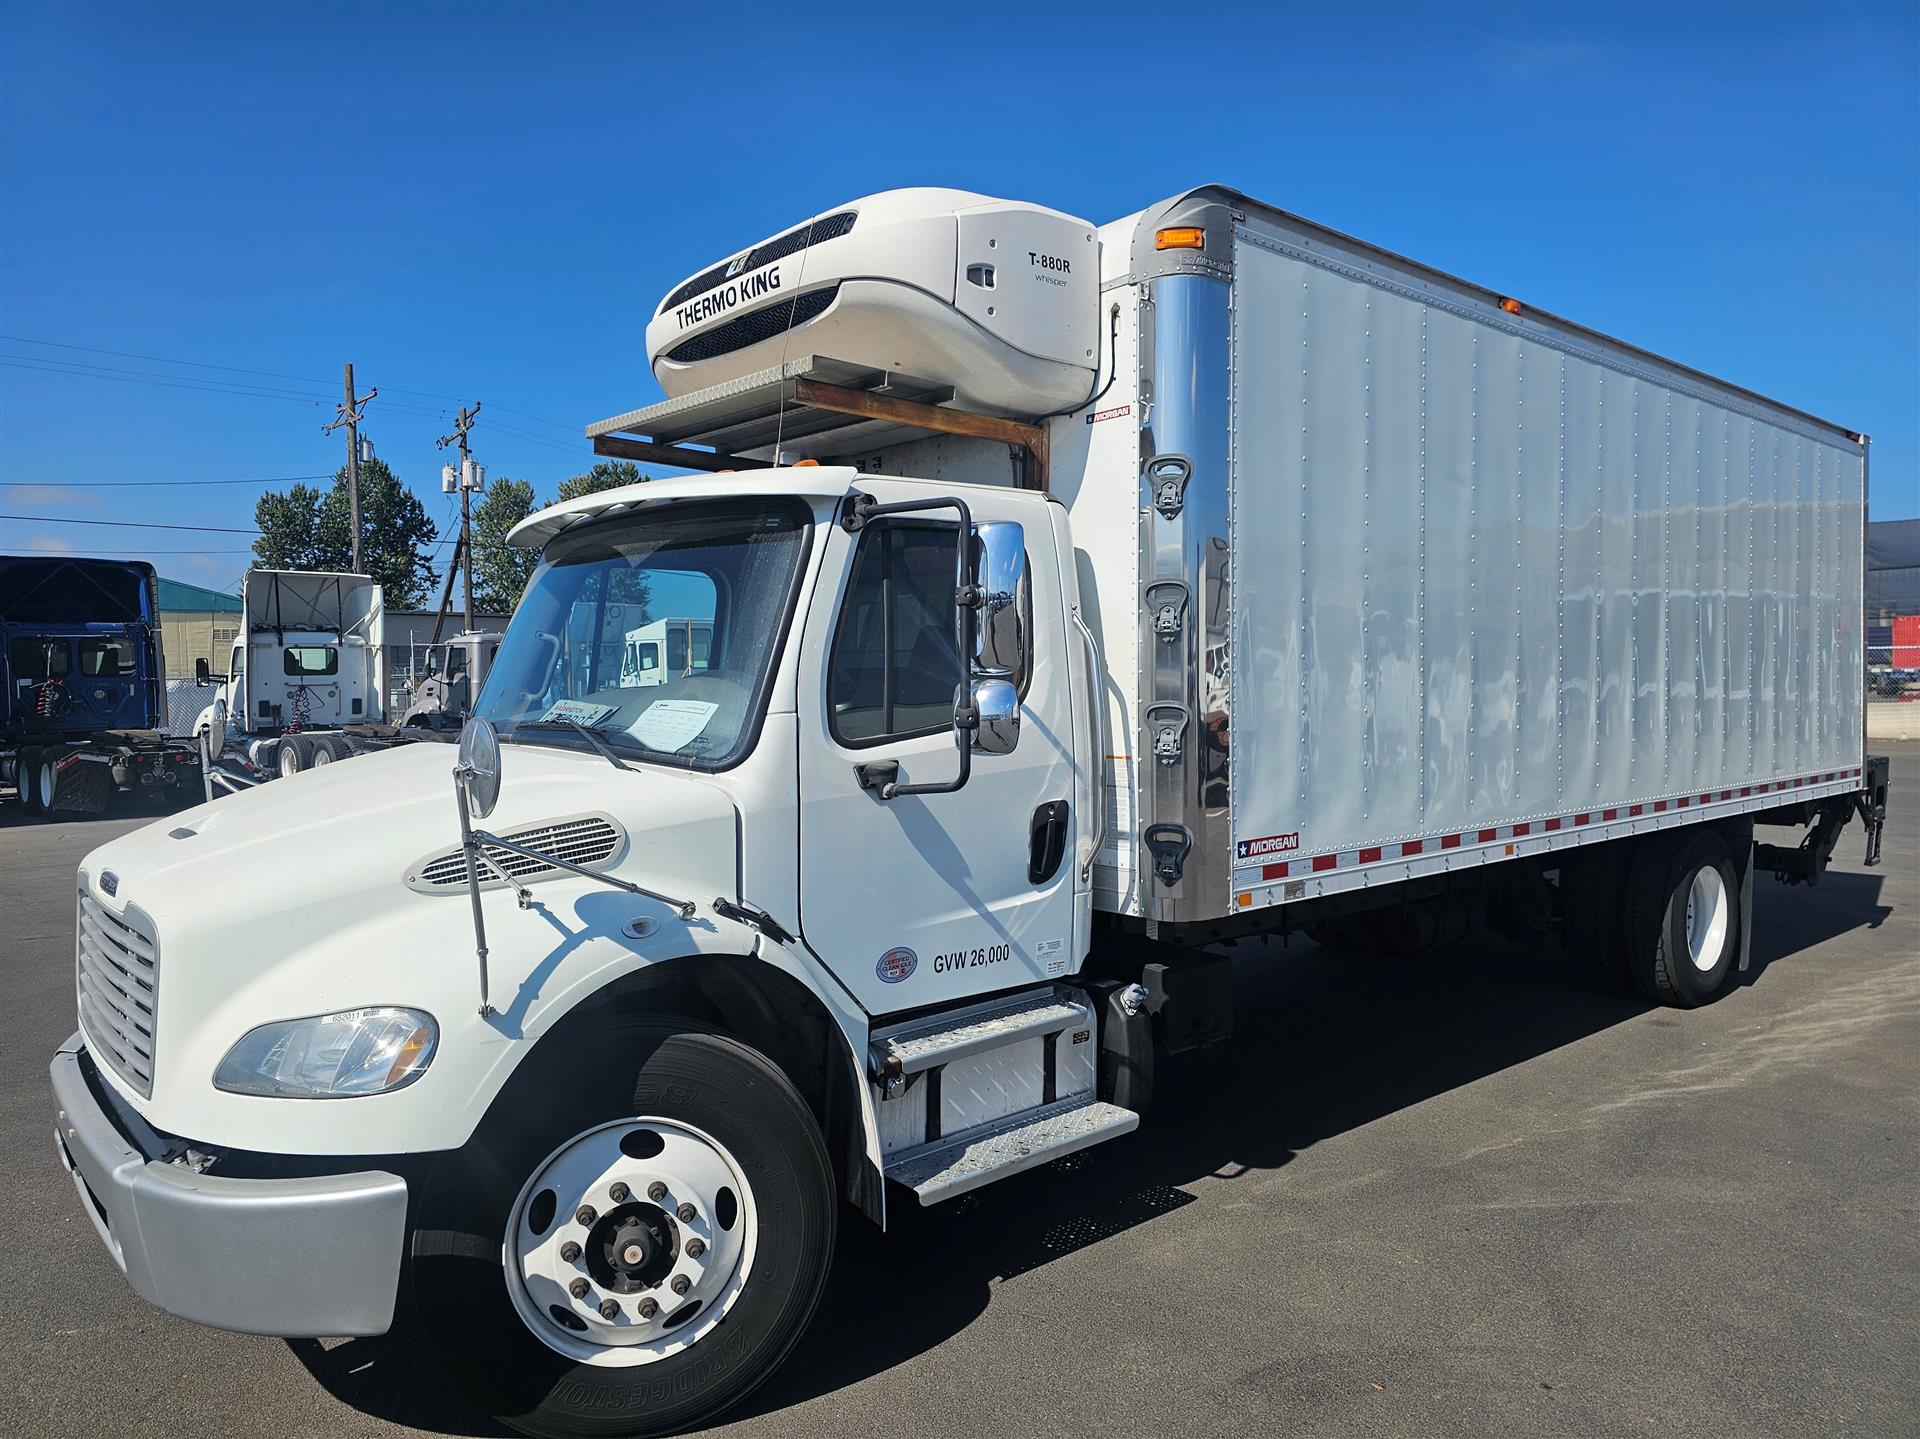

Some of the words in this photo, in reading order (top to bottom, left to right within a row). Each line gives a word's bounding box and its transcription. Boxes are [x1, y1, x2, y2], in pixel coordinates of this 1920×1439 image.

[1029, 252, 1071, 273] T-880R
[1035, 274, 1067, 287] whisper
[676, 286, 737, 330] THERMO
[740, 266, 781, 302] KING
[1094, 406, 1129, 421] MORGAN
[1249, 835, 1298, 855] MORGAN
[885, 956, 910, 966] CERTIFIED
[934, 951, 967, 973] GVW
[970, 944, 1010, 968] 26,000
[882, 964, 899, 972] CLEAN
[332, 1012, 360, 1022] 652011
[548, 1325, 751, 1412] BRIDGESTON
